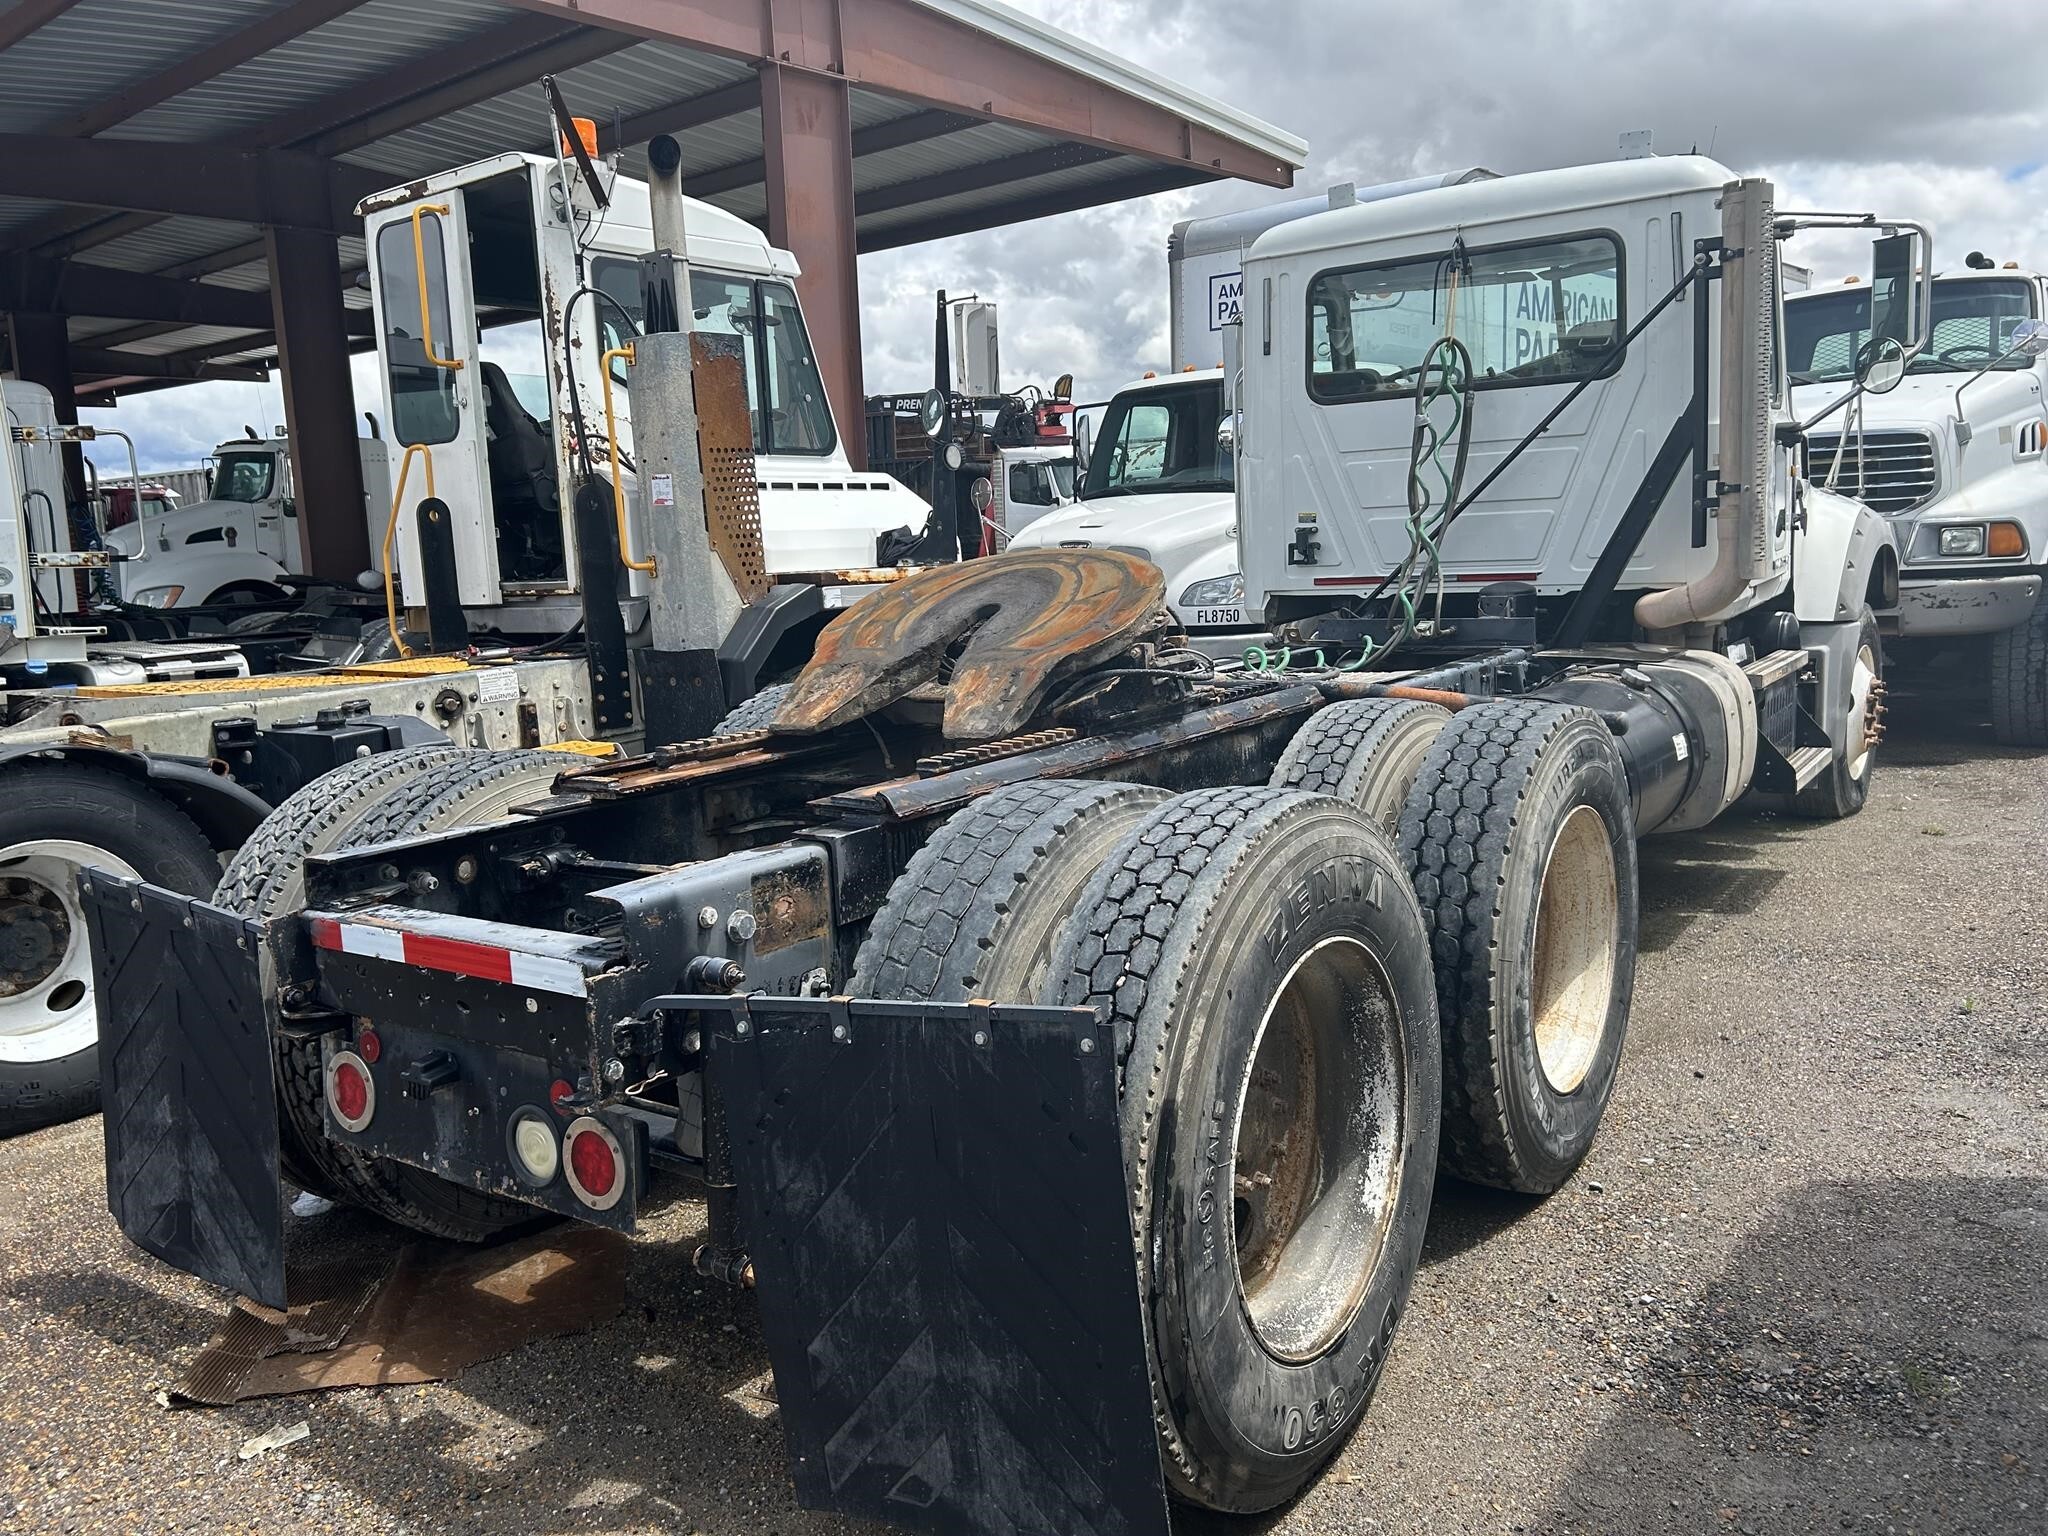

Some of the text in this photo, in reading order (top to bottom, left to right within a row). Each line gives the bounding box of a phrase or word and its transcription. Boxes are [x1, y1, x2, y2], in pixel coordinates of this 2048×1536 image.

[1197, 609, 1240, 623] FL8750
[487, 691, 519, 701] WARNING
[1264, 860, 1382, 965] ZENNA
